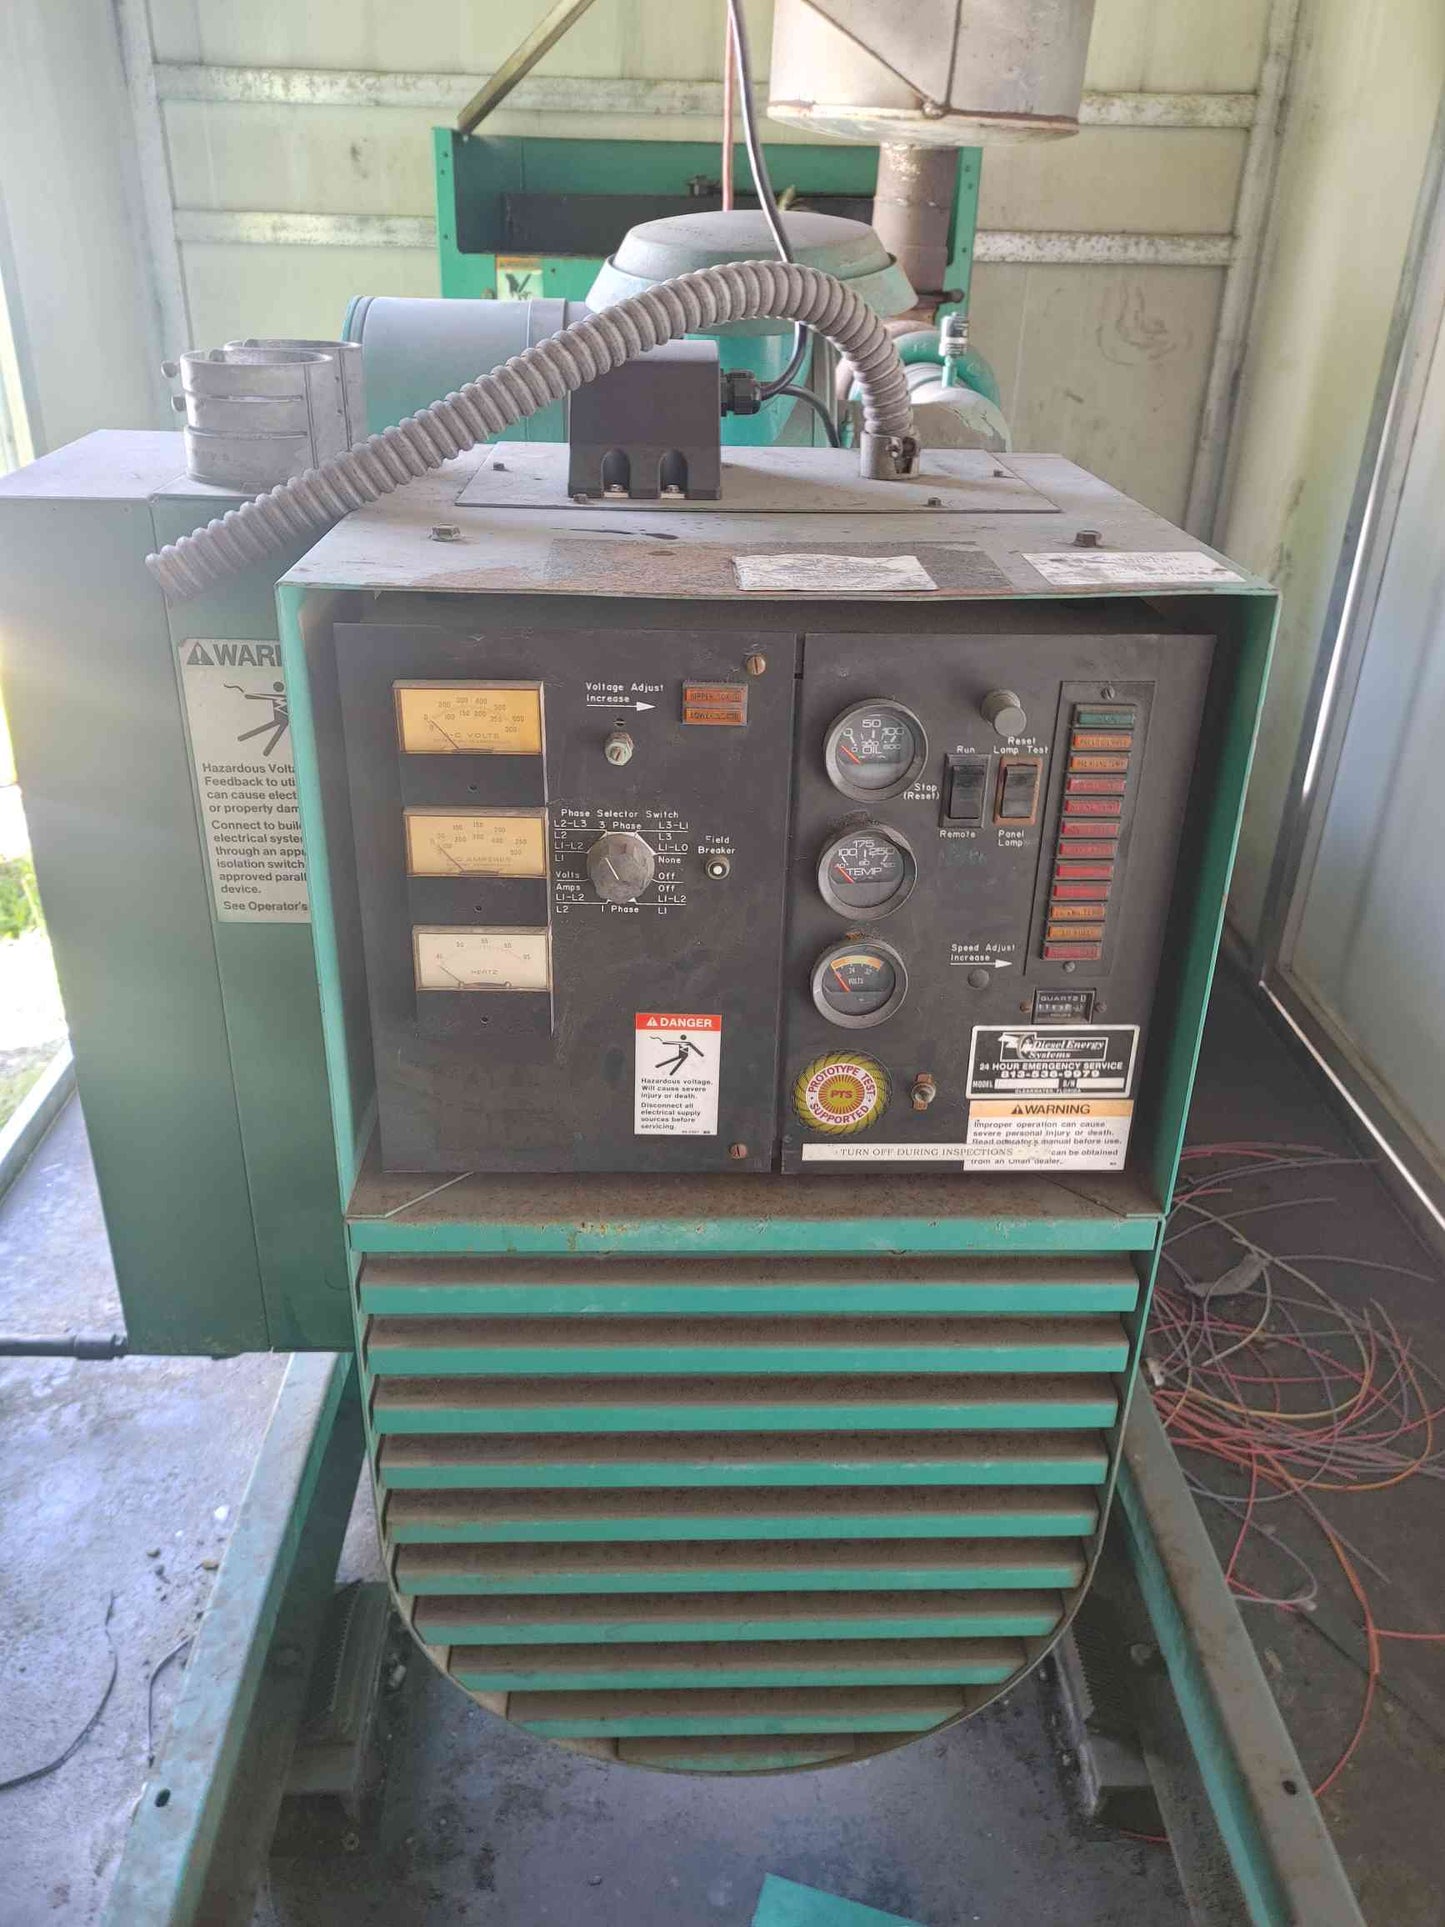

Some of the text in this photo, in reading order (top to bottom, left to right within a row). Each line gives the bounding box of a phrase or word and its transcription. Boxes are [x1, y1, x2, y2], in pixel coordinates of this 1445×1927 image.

[586, 683, 664, 693] Voltage Adjust
[586, 694, 630, 703] Increase
[843, 728, 853, 736] 0
[862, 720, 881, 728] 50
[1008, 737, 1036, 745] Reset
[993, 746, 1048, 755] Lamp Test
[202, 763, 265, 773] Hazardous
[205, 776, 262, 786] Feedback
[266, 778, 277, 786] to
[914, 783, 937, 792] Stop
[207, 791, 228, 799] can
[903, 792, 940, 800] (Reset)
[224, 804, 272, 814] property
[561, 809, 679, 818] Phase Selector Switch
[212, 820, 261, 830] Connect
[264, 821, 275, 830] to
[554, 820, 587, 828] L2-L3
[600, 821, 642, 830] 3 Phase
[658, 821, 689, 829] L3-L1
[214, 834, 267, 842] electrical
[554, 831, 567, 839] L2
[940, 830, 976, 838] Remote
[998, 830, 1024, 838] Panel
[706, 835, 729, 843] Field
[998, 838, 1023, 846] Lamp
[853, 840, 875, 848] 175
[216, 847, 259, 857] through
[698, 846, 736, 854] Breaker
[217, 859, 305, 868] isolation switch
[658, 856, 681, 864] None
[556, 871, 580, 879] Volts
[846, 867, 882, 876] TEMP
[219, 872, 272, 882] approved
[221, 885, 261, 893] device.
[224, 901, 245, 910] See
[611, 905, 639, 913] Phase
[952, 943, 1015, 953] Speed Adjust
[660, 1018, 712, 1027] DANGER
[1034, 1040, 1104, 1050] Diesel Energy
[808, 1066, 875, 1095] PROTOTYPE TEST
[973, 1080, 993, 1088] MODEL
[831, 1090, 853, 1098] PTS
[810, 1103, 869, 1123] SUPPORTED
[1025, 1104, 1091, 1115] WARNING
[974, 1120, 1012, 1128] Improper
[1006, 1130, 1042, 1138] personal
[1046, 1130, 1071, 1138] injury
[942, 1148, 1013, 1156] INSPECTIONS
